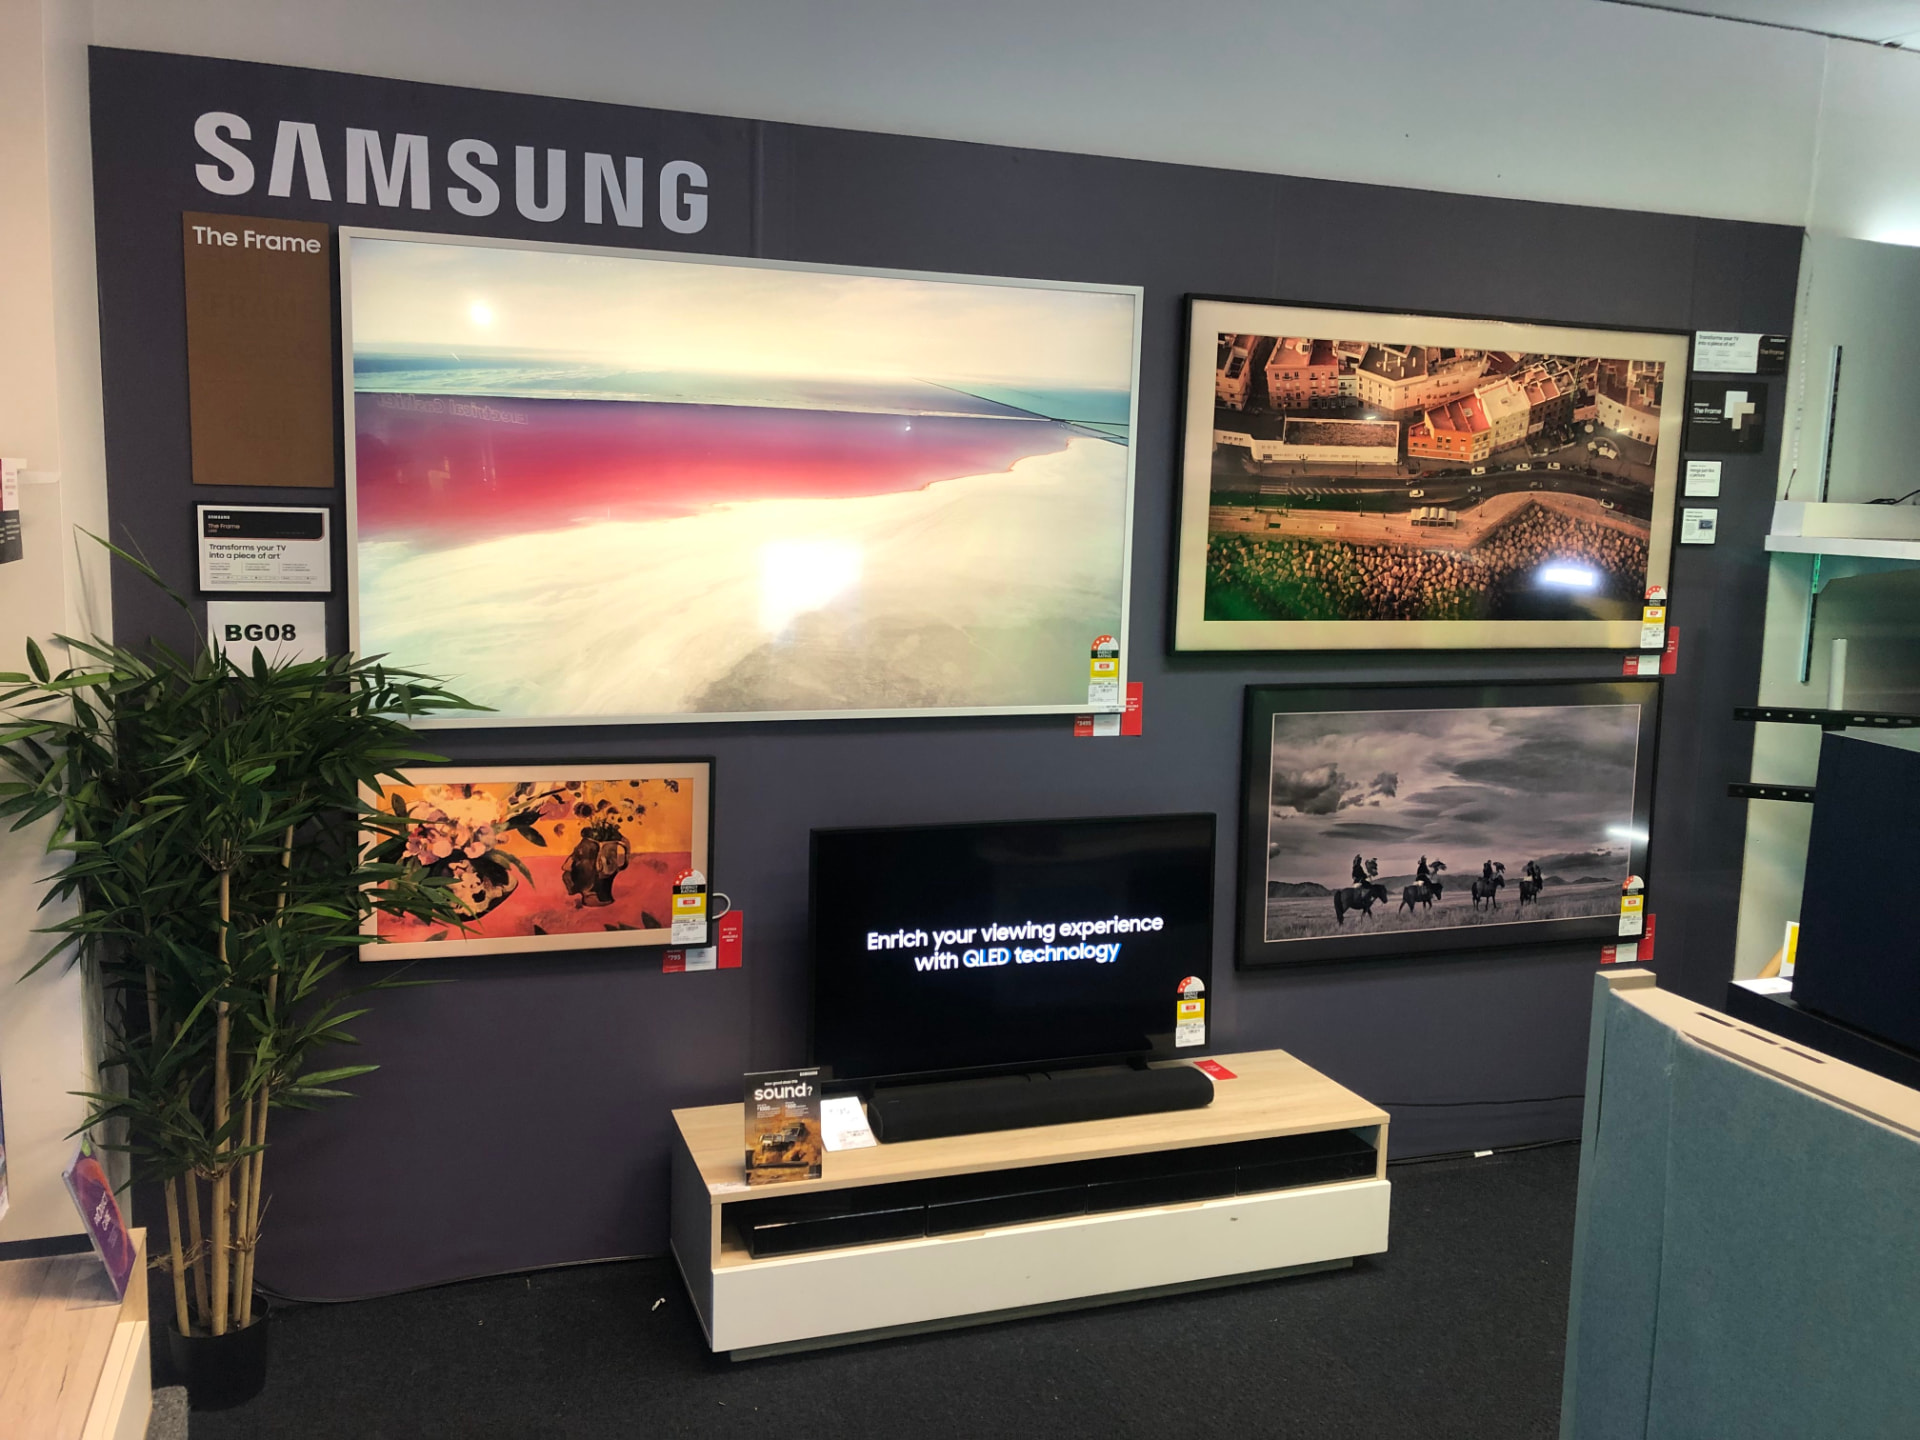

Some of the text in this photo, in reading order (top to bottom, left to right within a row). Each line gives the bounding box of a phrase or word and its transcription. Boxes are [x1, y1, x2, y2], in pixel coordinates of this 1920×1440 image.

[194, 111, 709, 234] SAMSUNG
[192, 225, 321, 254] The Frame
[233, 552, 256, 560] piece
[225, 624, 296, 641] BG08
[867, 915, 1164, 951] Enrich your viewing experience
[914, 942, 1122, 971] with QLED technology
